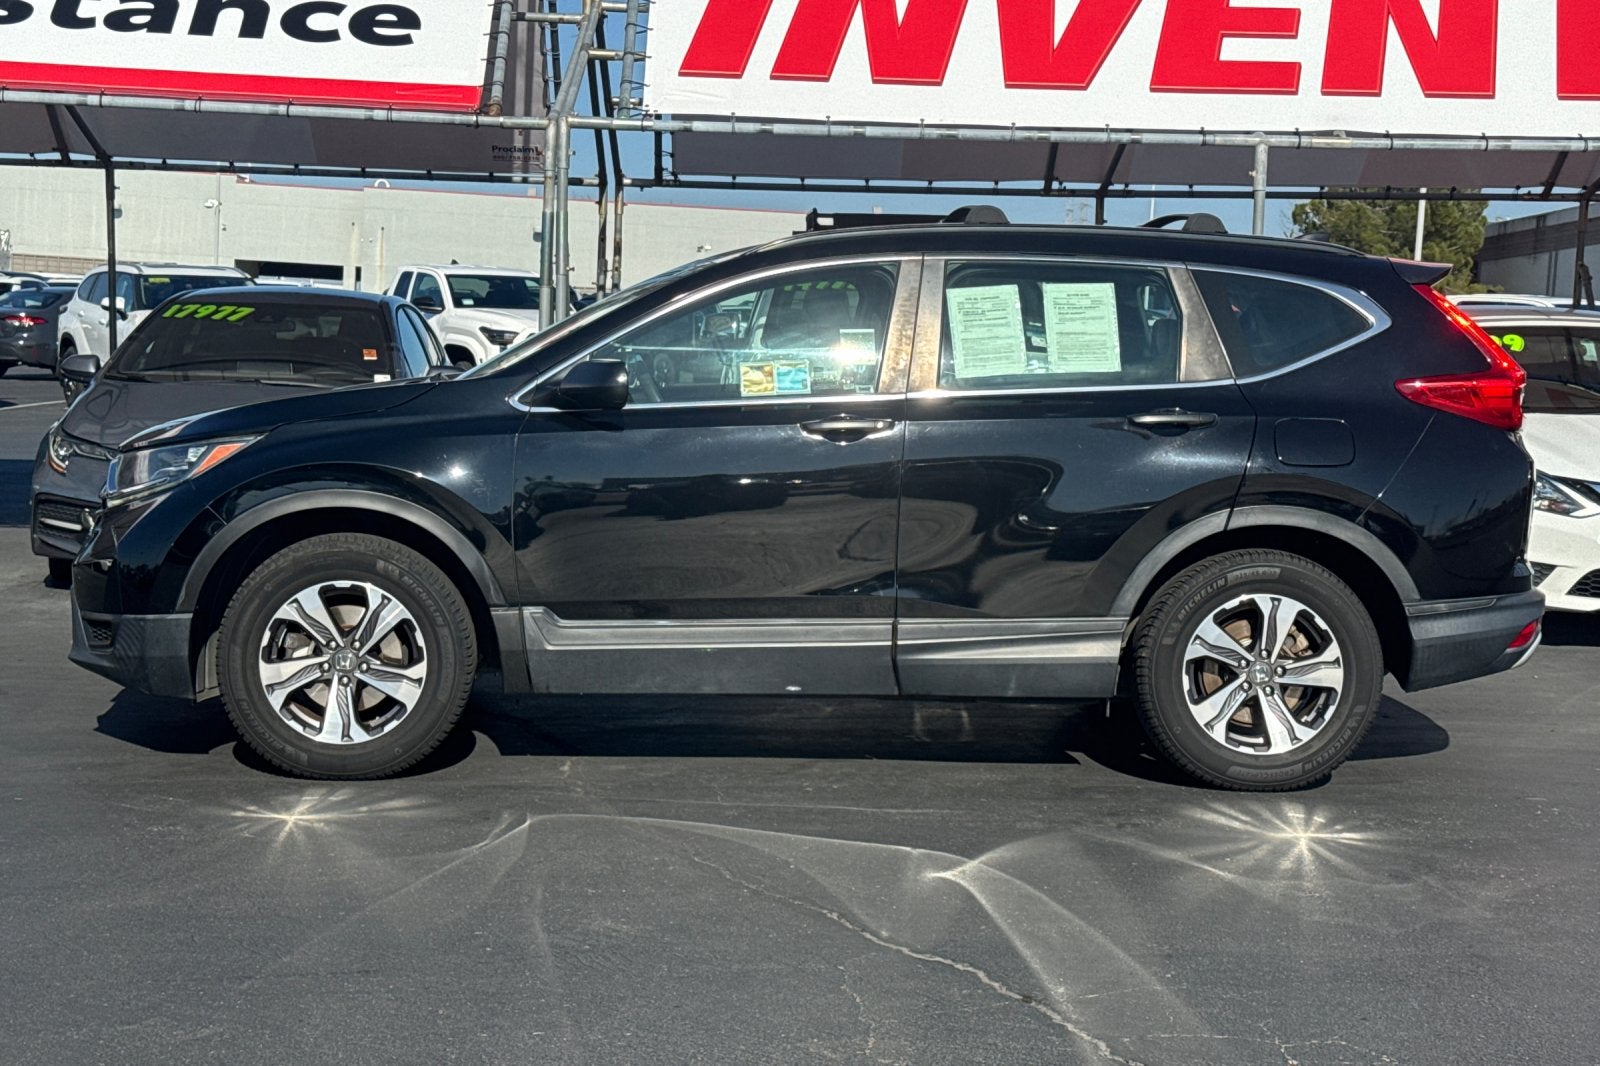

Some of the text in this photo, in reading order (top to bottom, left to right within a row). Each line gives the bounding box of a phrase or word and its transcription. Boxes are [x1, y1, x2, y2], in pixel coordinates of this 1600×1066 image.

[678, 0, 1600, 101] INVEN
[162, 304, 256, 322] 17977
[1177, 577, 1227, 621] MICHELIN
[1302, 727, 1354, 772] MICHELIN
